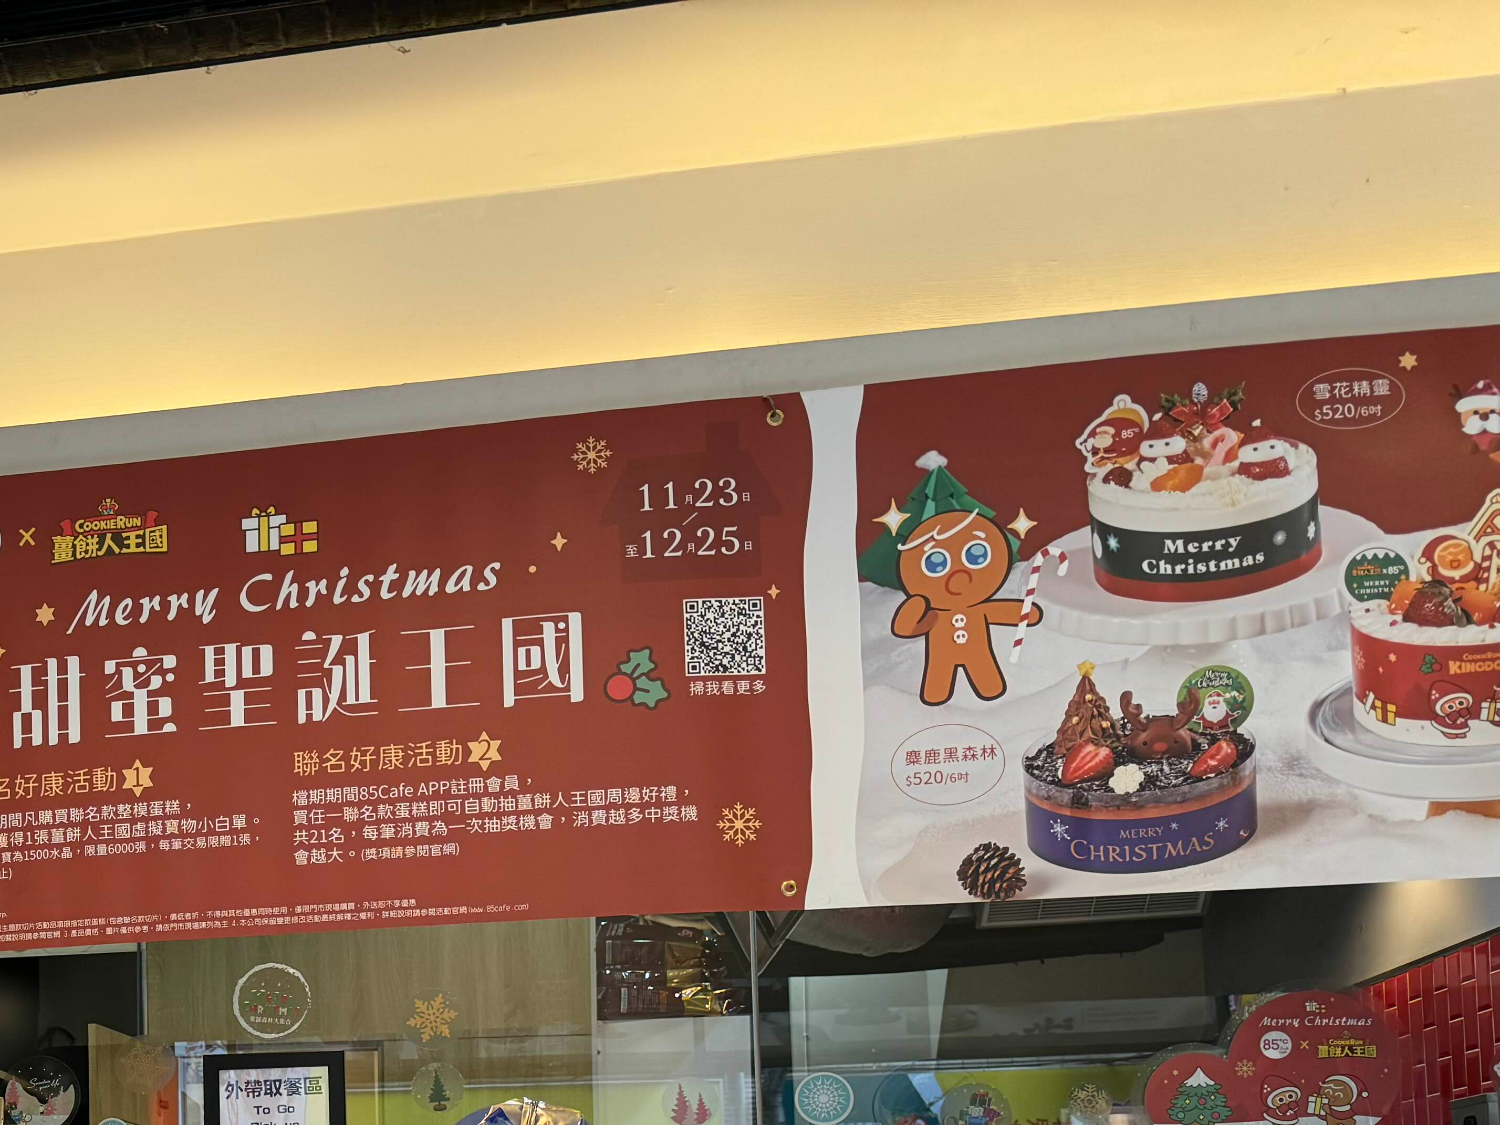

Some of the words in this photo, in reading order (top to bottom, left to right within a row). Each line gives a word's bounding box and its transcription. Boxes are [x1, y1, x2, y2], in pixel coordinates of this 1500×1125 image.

[1313, 378, 1391, 400] 雪花精靈
[1314, 403, 1382, 421] $520/6吋
[638, 477, 751, 512] 11月23日
[51, 525, 168, 564] 薑餅人王國
[624, 526, 753, 560] 至12月25日
[1163, 535, 1242, 555] Merry
[1141, 550, 1265, 576] Christmas
[66, 587, 220, 635] Merry
[239, 560, 501, 613] Christmas
[1355, 587, 1395, 595] CHRISTMA
[8, 611, 585, 748] 甜蜜聖誕王國
[688, 679, 767, 697] 掃我看更多
[293, 739, 464, 777] 聯名好康活動
[905, 745, 998, 766] 麋鹿黑森林
[905, 769, 969, 787] $520/6吋
[1119, 826, 1164, 840] MERRY
[1070, 832, 1215, 863] CHRISTMAS
[1259, 1016, 1300, 1028] Merry
[1305, 1016, 1372, 1026] Christmas
[1317, 1045, 1377, 1058] 薑餅人王國
[225, 1076, 323, 1100] 外帶取餐區
[253, 1105, 271, 1115] To
[277, 1104, 295, 1114] Go
